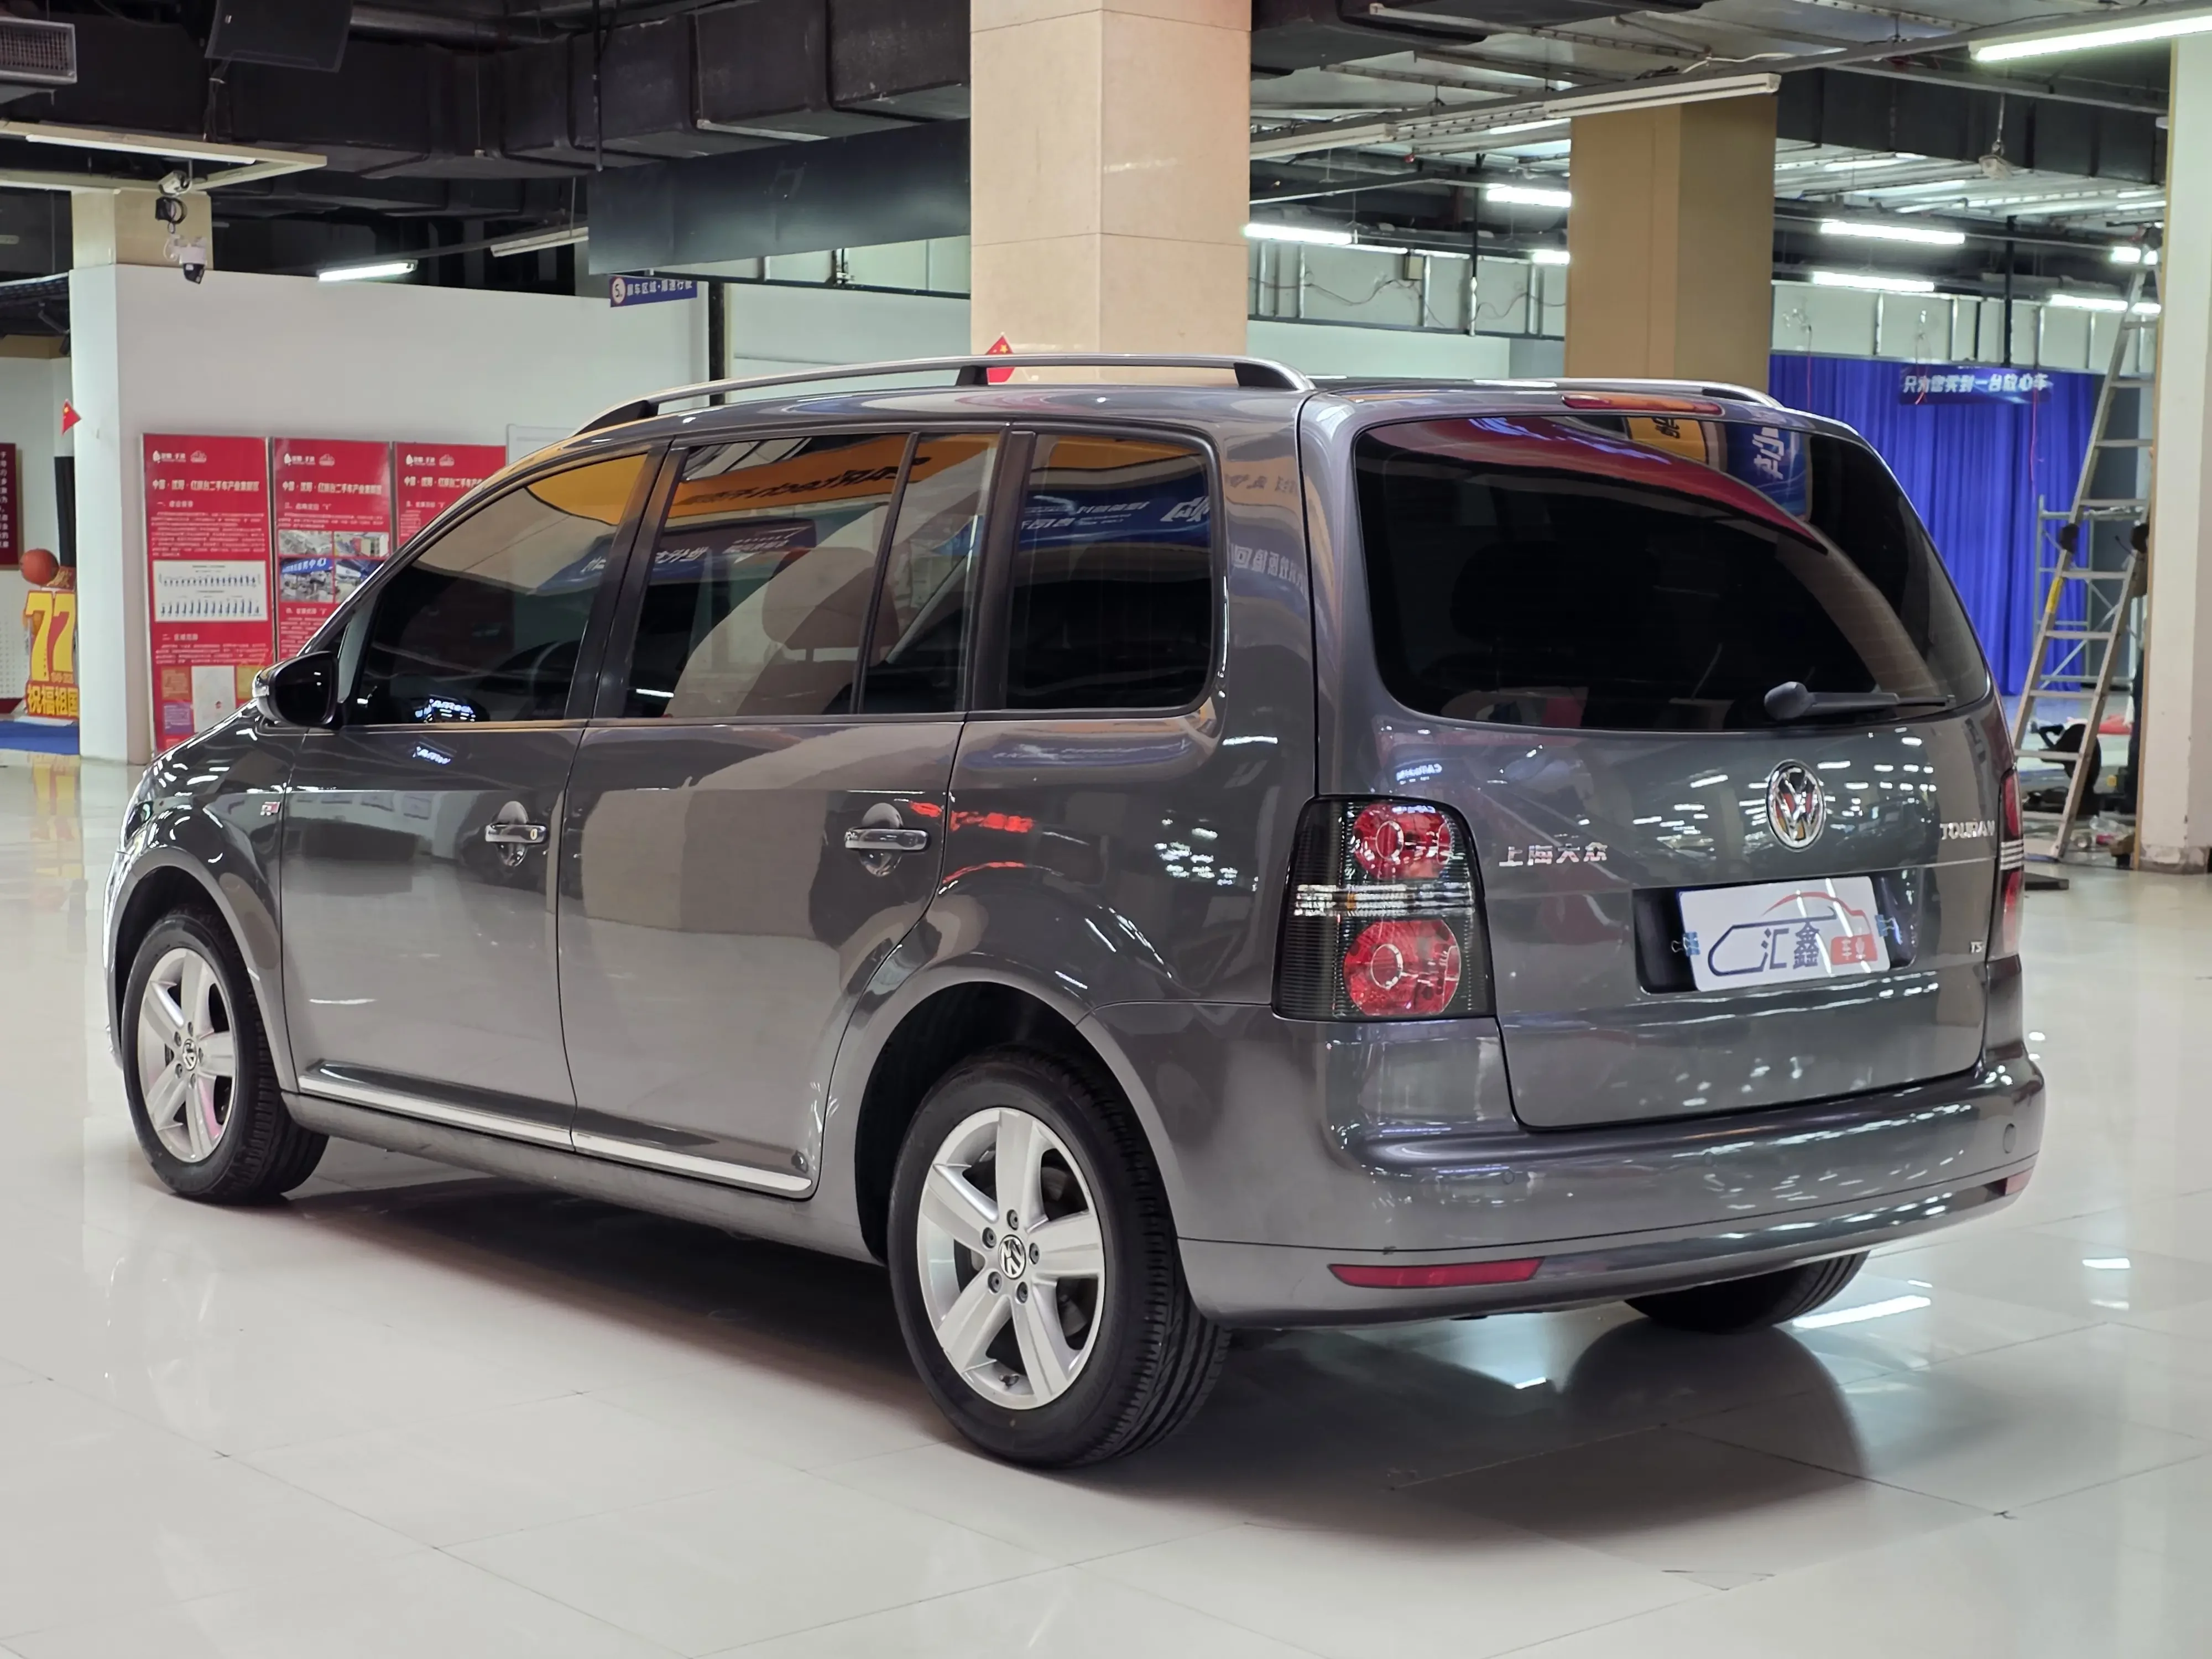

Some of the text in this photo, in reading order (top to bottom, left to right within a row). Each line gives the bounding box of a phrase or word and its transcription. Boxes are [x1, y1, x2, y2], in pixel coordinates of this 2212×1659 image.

[26, 591, 75, 681] 77
[28, 684, 79, 717] 祝福祖国
[1939, 820, 1995, 839] TOURAN
[1499, 842, 1608, 867] 上海大众
